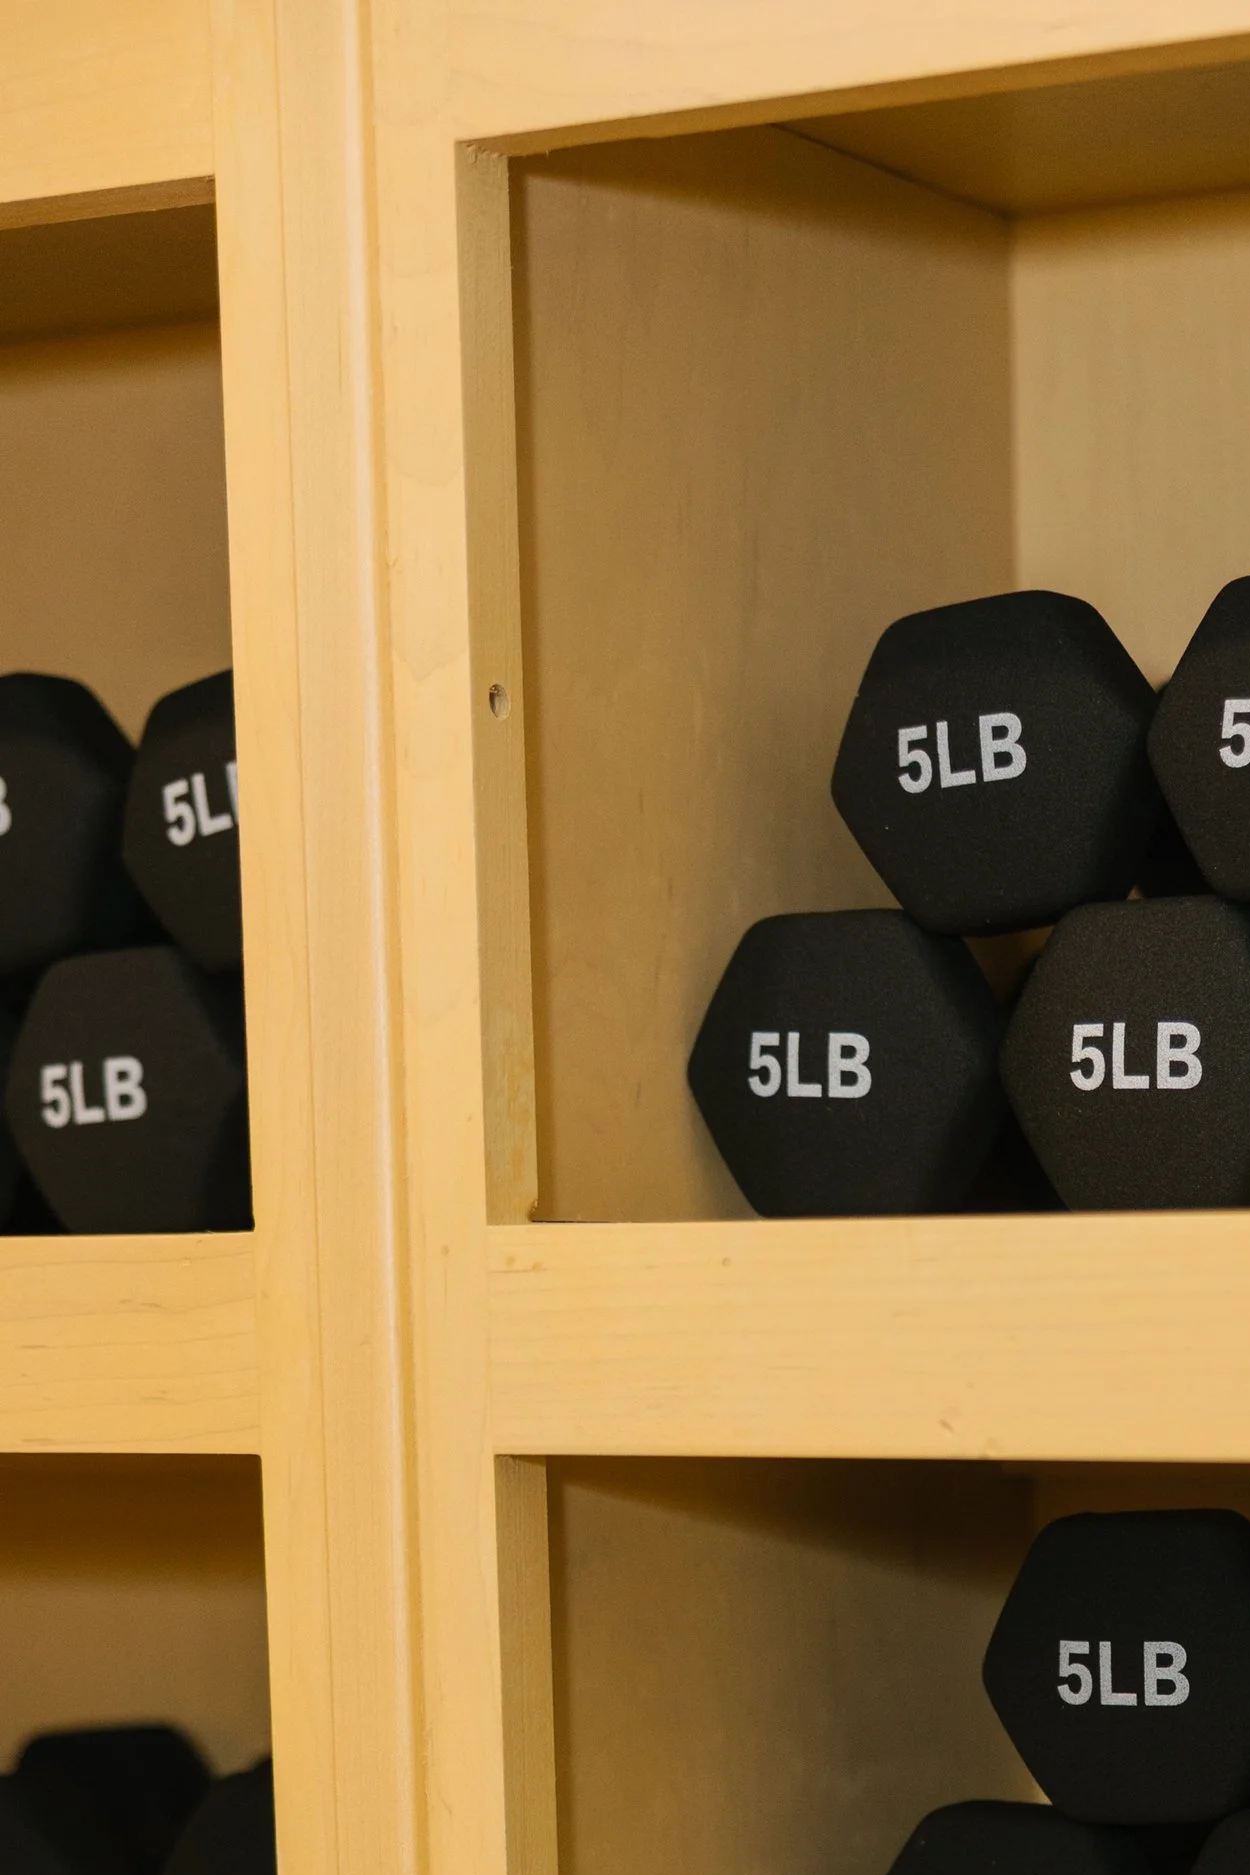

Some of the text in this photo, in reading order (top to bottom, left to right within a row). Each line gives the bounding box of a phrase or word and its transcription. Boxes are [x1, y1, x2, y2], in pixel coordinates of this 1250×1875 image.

[896, 710, 1028, 795] 5LB
[161, 760, 240, 847] 5L
[40, 1055, 148, 1129] 5LB
[747, 1030, 873, 1100] 5LB
[1068, 1020, 1204, 1093] 5LB
[1056, 1638, 1191, 1708] 5LB
